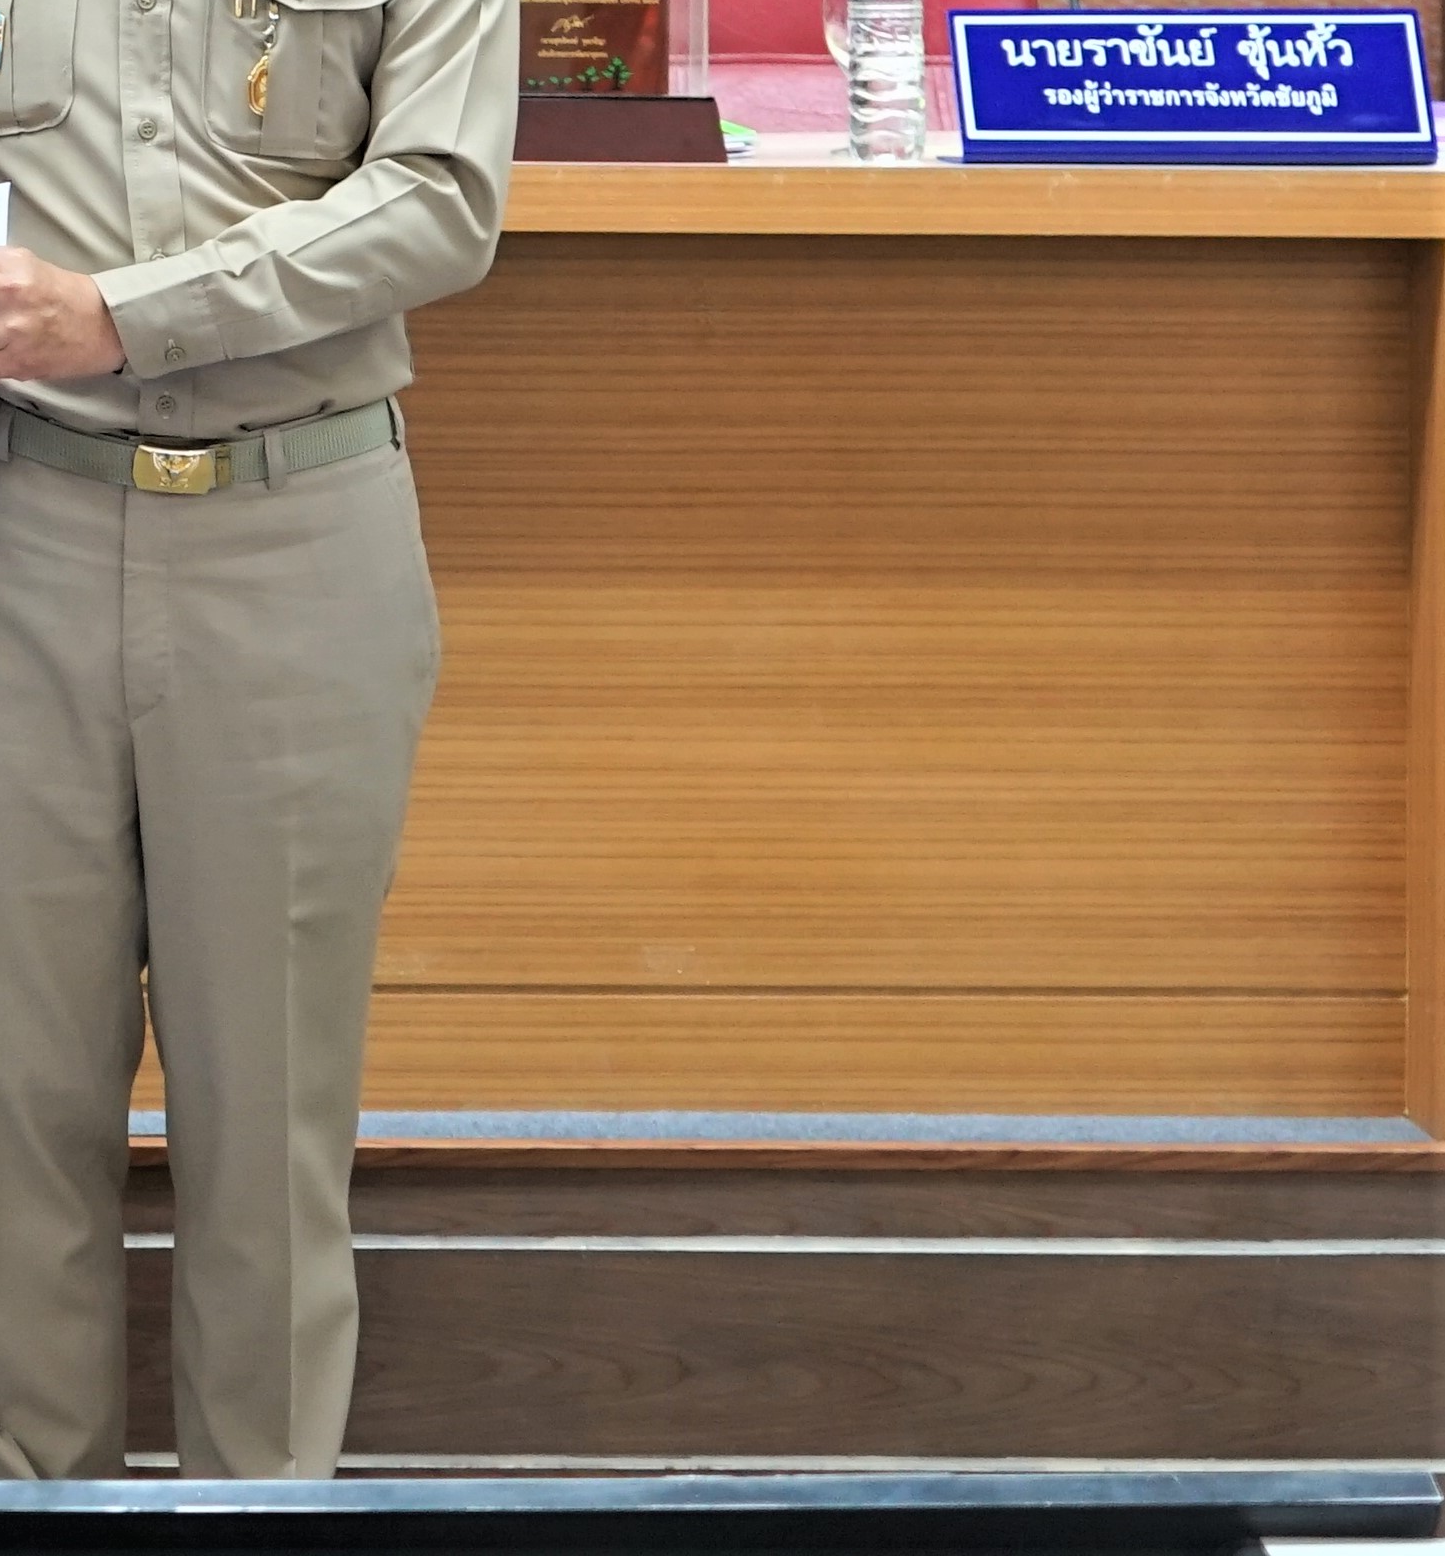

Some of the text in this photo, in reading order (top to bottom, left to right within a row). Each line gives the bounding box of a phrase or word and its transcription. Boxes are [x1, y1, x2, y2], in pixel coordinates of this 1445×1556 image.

[1000, 23, 1219, 68] นายราชันย์
[1043, 80, 1339, 115] รองผู้ว่าราชการจังหวัดชัยภูมิ
